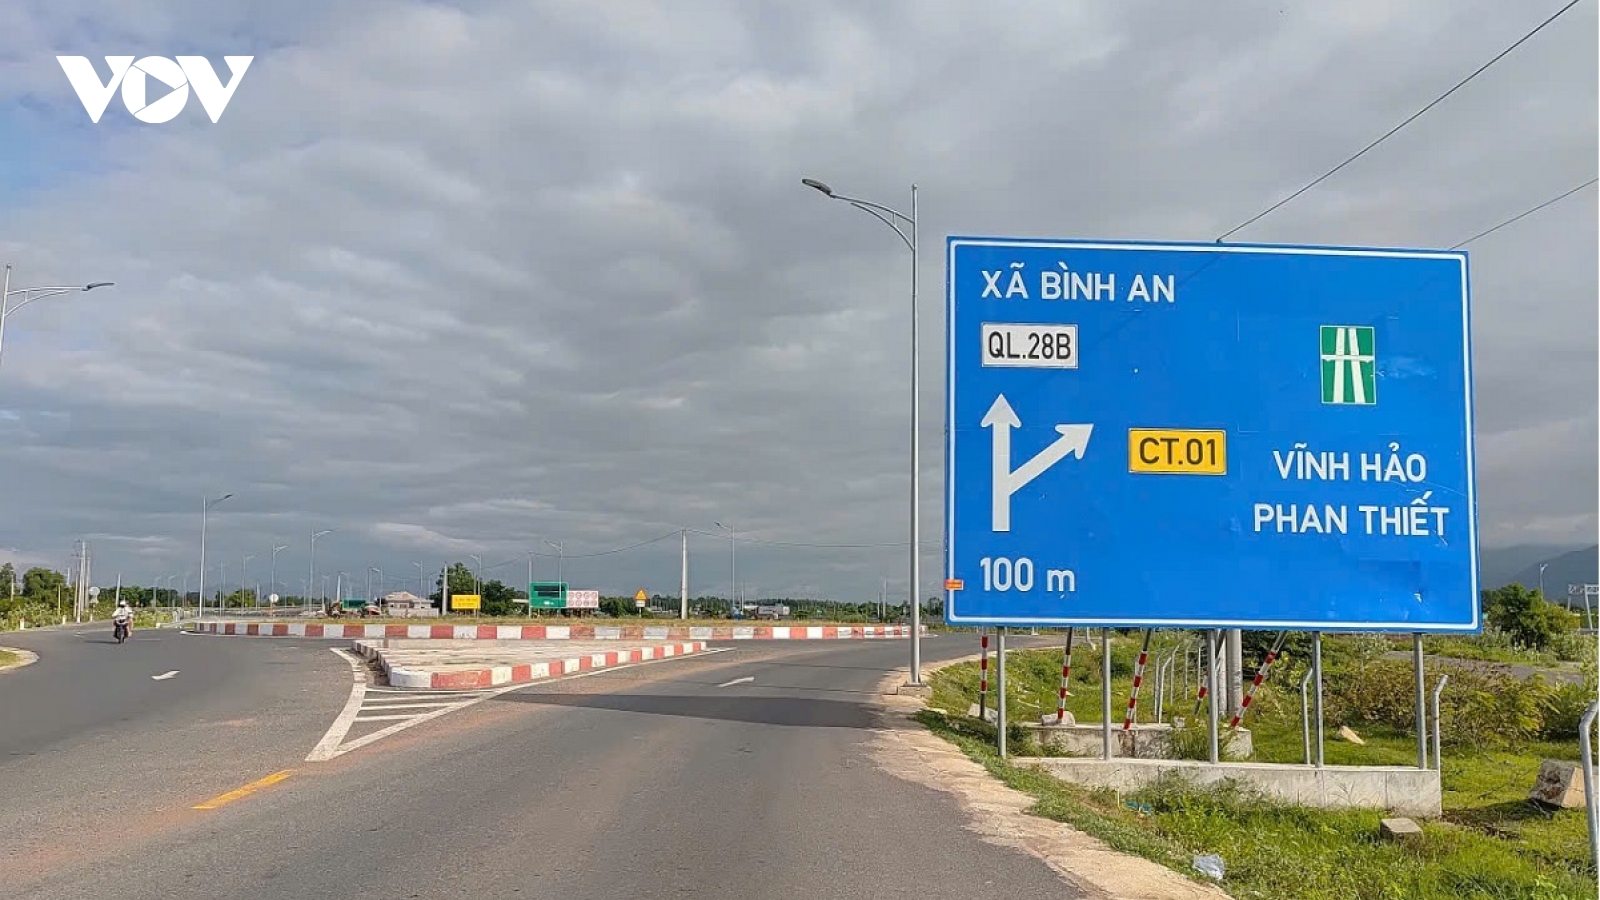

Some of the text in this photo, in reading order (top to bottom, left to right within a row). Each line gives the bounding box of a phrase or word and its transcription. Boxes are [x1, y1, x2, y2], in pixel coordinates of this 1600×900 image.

[981, 261, 1175, 303] XÃ BÌNH AN
[988, 331, 1071, 360] QL.28B
[1138, 437, 1217, 466] CT.01
[1273, 442, 1427, 483] VĨNH HẢO
[1254, 490, 1450, 536] PHAN THIẾT
[980, 557, 1075, 592] 100 m
